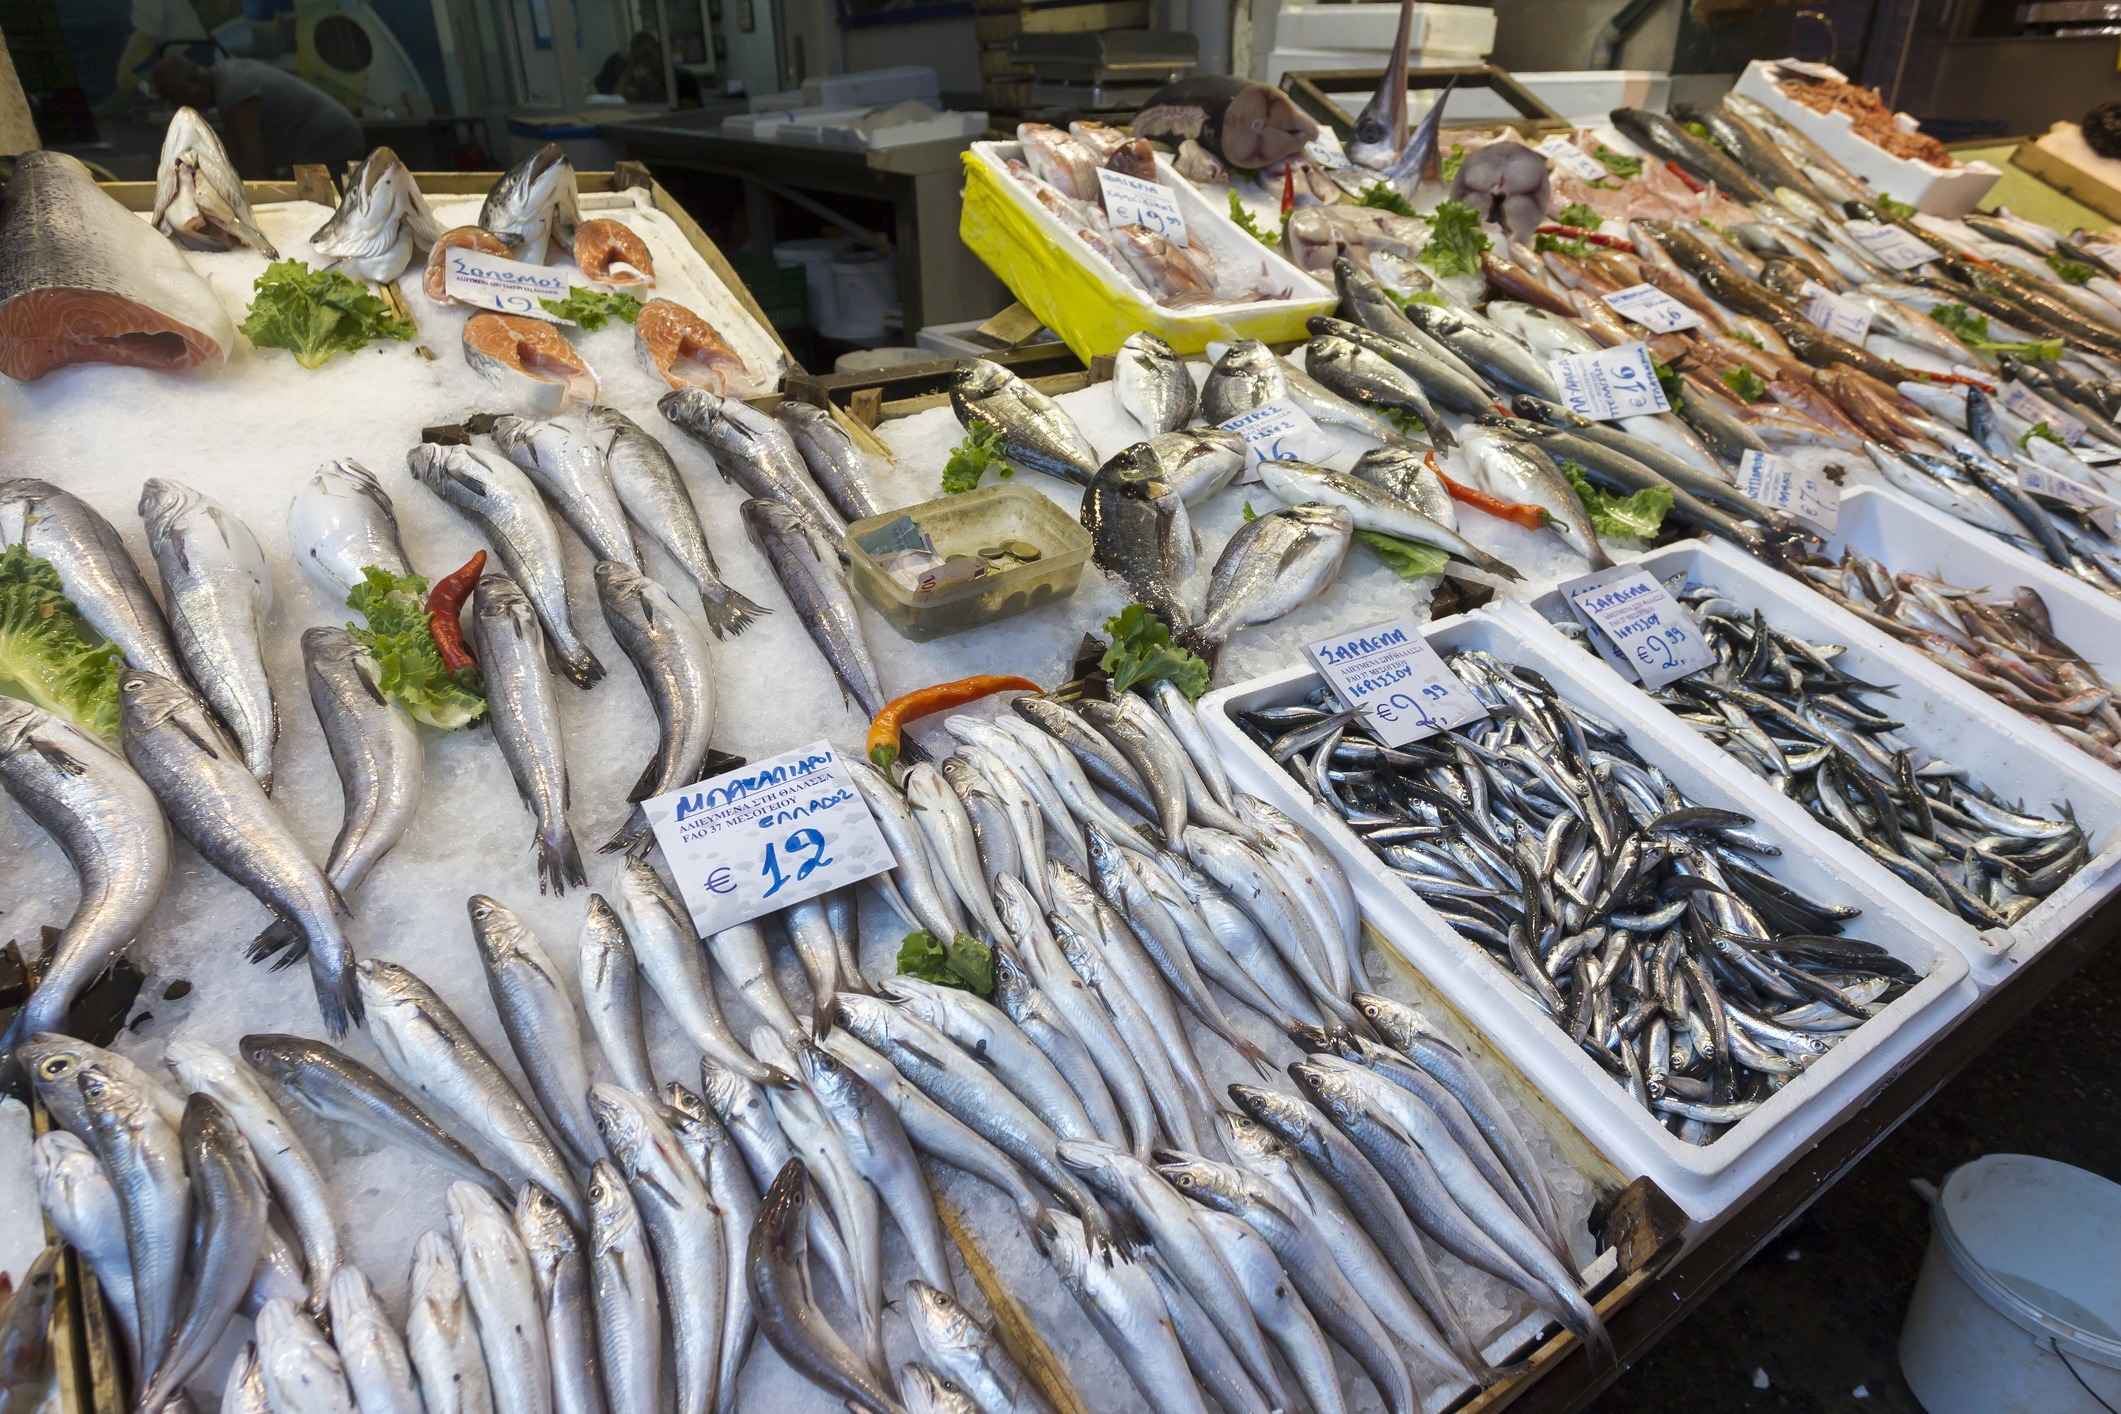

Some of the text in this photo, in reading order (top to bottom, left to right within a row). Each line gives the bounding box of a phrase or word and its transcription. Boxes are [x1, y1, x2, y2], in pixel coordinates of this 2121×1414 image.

[1614, 613, 1660, 639] ΙΕΡΙΣΣΟΥ
[1340, 659, 1382, 675] ΑΛΙΕΥΜΕΝΑ
[1394, 645, 1424, 659] ΘΑΛΑΣΣΑ
[1345, 659, 1408, 683] FAO 37 ΜΕΣΟΓΕΙΟΥ
[1348, 665, 1412, 698] ΙΕΡΙΣΣΟΥ
[679, 773, 834, 833] ΑΛΙΕΥΜΕΝΑ ΣΤΗ ΘΑΛΑΣΣΑ
[683, 796, 798, 843] FAO 37 ΜΕΣΟΓΕΙΟΥ
[762, 828, 833, 898] 12
